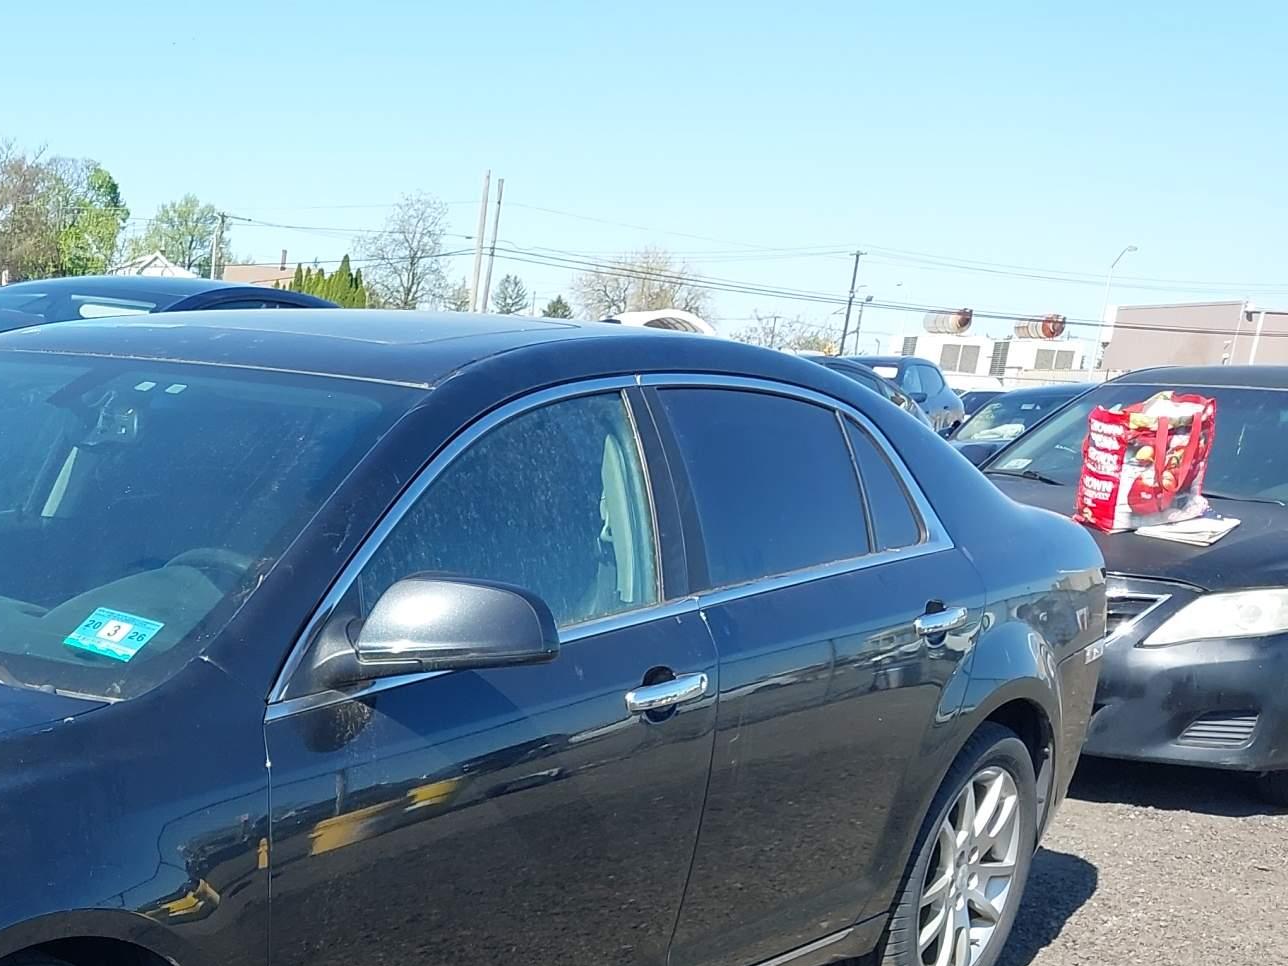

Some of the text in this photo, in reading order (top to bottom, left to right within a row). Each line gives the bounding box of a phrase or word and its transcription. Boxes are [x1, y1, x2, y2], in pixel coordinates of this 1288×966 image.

[84, 619, 103, 630] 20
[107, 625, 121, 637] 3
[127, 631, 147, 643] 26
